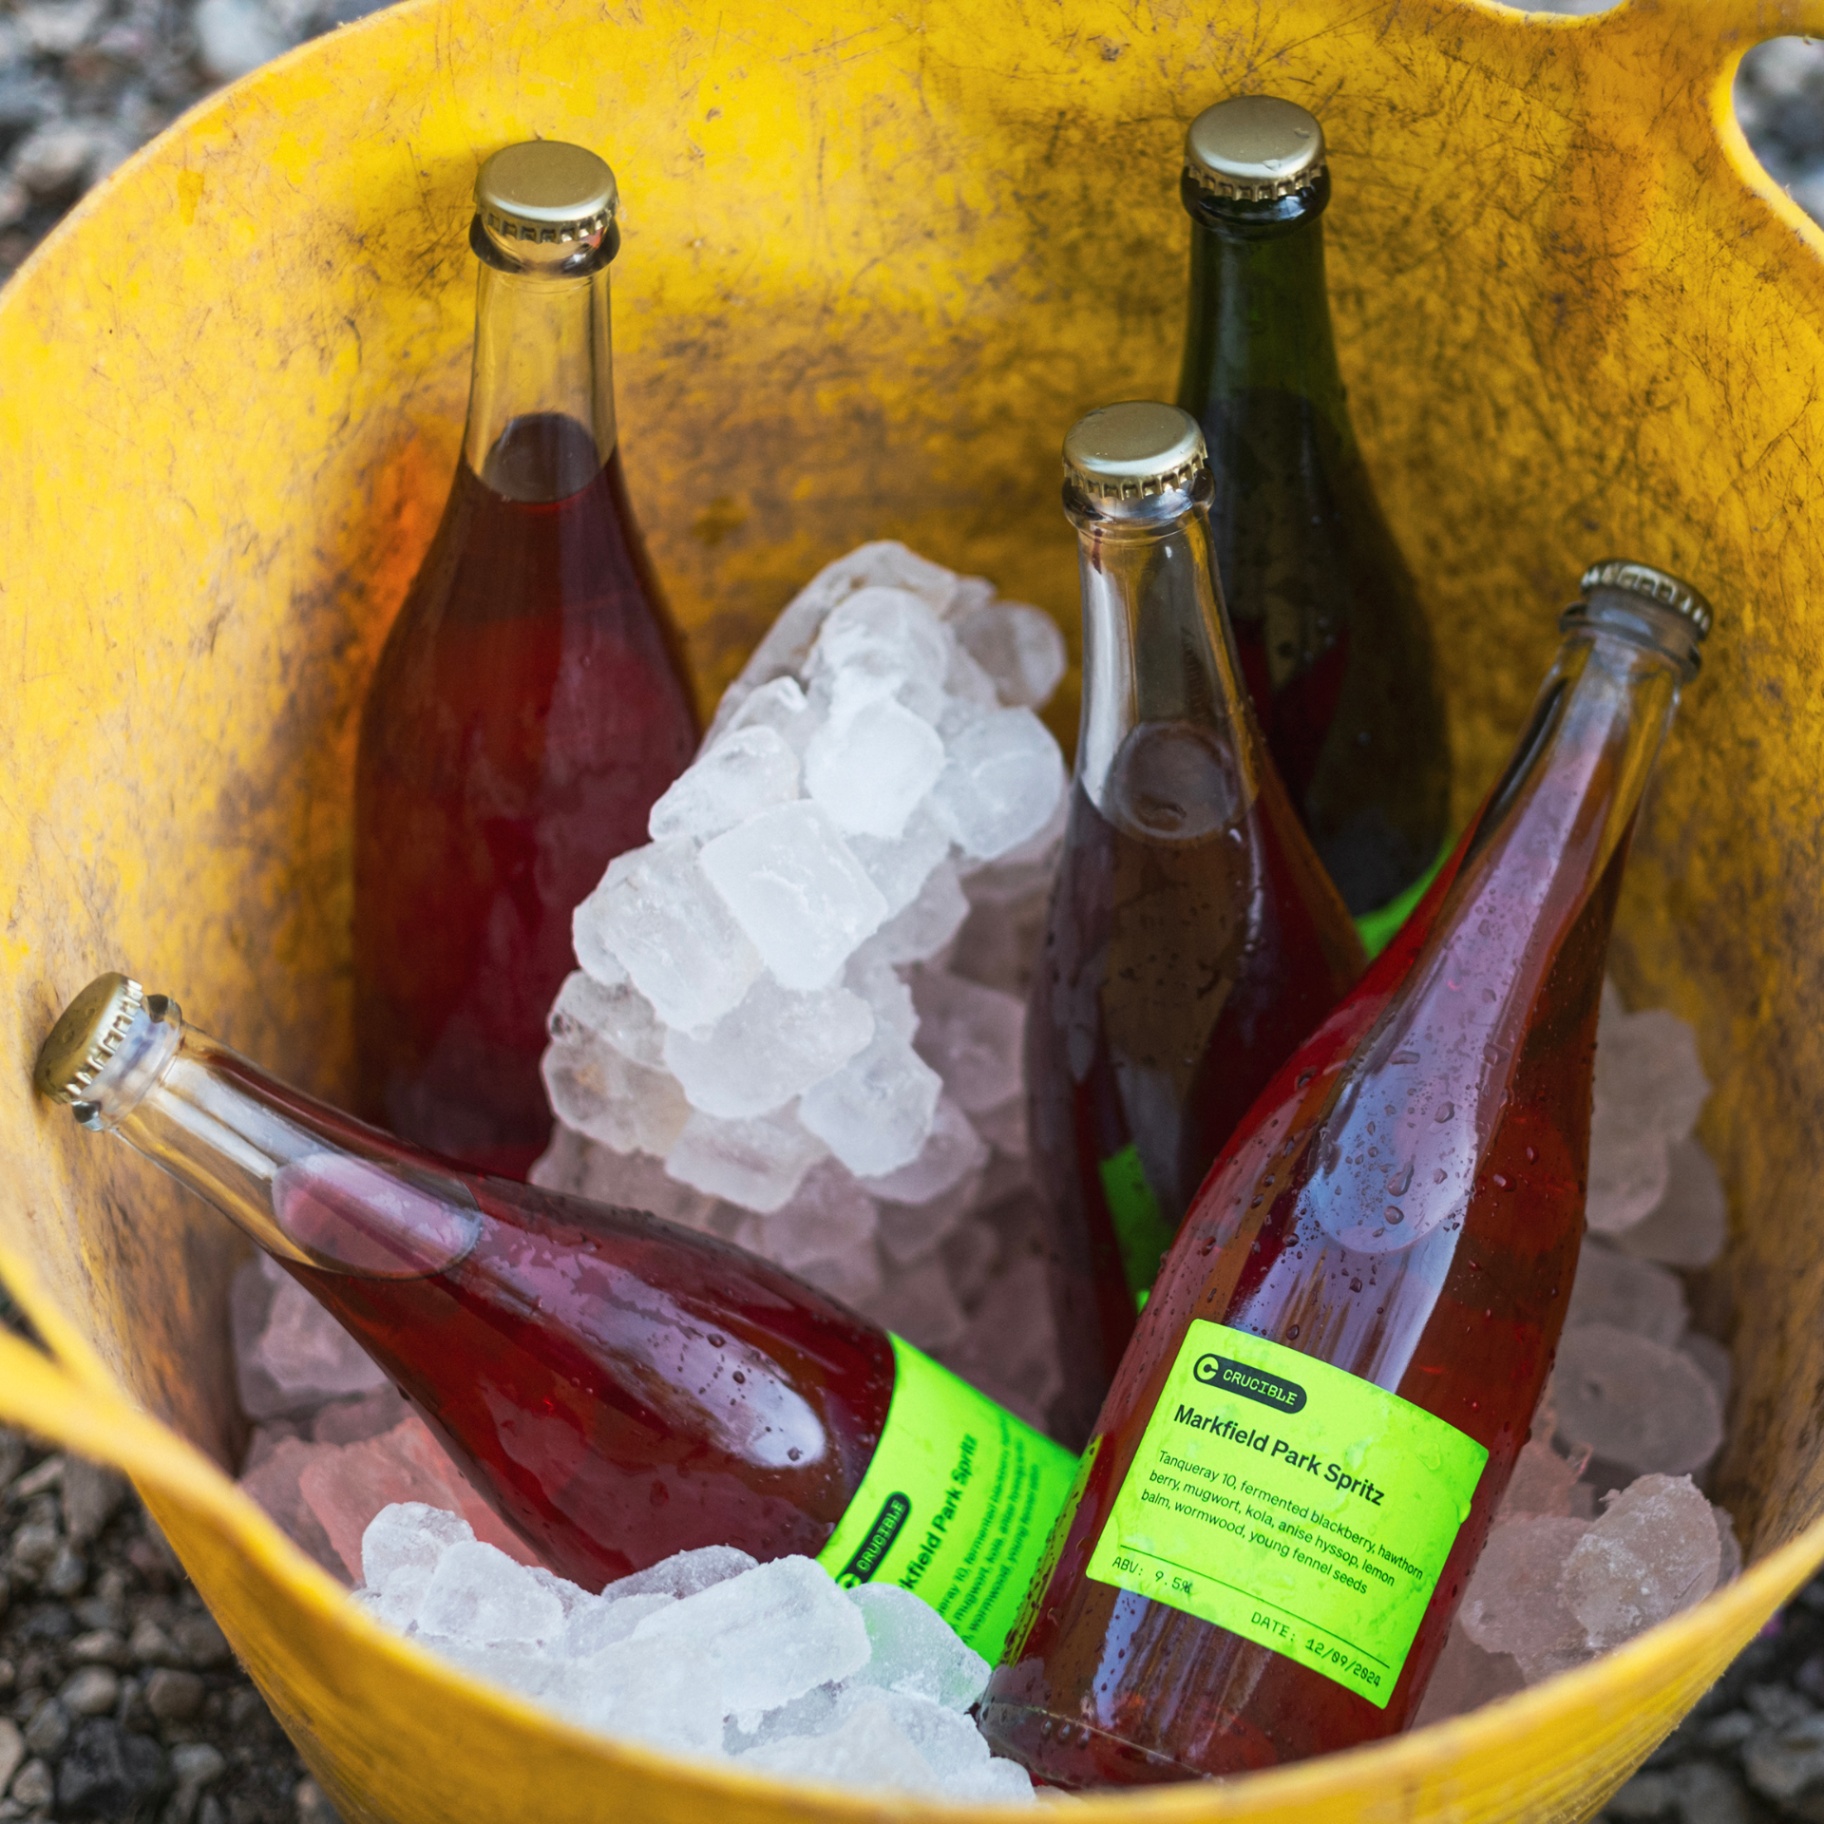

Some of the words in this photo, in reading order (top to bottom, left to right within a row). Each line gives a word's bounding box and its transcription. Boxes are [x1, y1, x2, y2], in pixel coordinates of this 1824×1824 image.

[1223, 1369, 1298, 1405] CRUCIBLE
[1174, 1404, 1269, 1452] Markfield
[1270, 1439, 1322, 1475] Park
[1324, 1463, 1385, 1506] Spritz
[931, 1486, 962, 1532] Park
[1141, 1489, 1171, 1510] balm,
[1174, 1502, 1246, 1538] wormwood,
[1248, 1531, 1290, 1558] young
[1292, 1547, 1333, 1575] fennel
[1332, 1569, 1367, 1594] seeds
[1149, 1470, 1181, 1491] berry,
[1183, 1483, 1241, 1514] mugwort,
[1245, 1504, 1274, 1528] kola,
[1278, 1521, 1313, 1543] anise
[1315, 1535, 1359, 1568] hyssop,
[1361, 1559, 1395, 1587] lemon
[1159, 1450, 1220, 1482] Tanqueray
[1222, 1473, 1237, 1491] 10,
[1240, 1480, 1309, 1518] fermented
[1310, 1510, 1376, 1554] blackberry,
[1377, 1544, 1423, 1580] hawthorn
[1112, 1556, 1144, 1576] ABV:
[1250, 1611, 1296, 1642] DATE:
[1304, 1638, 1381, 1687] 12/09/2024
